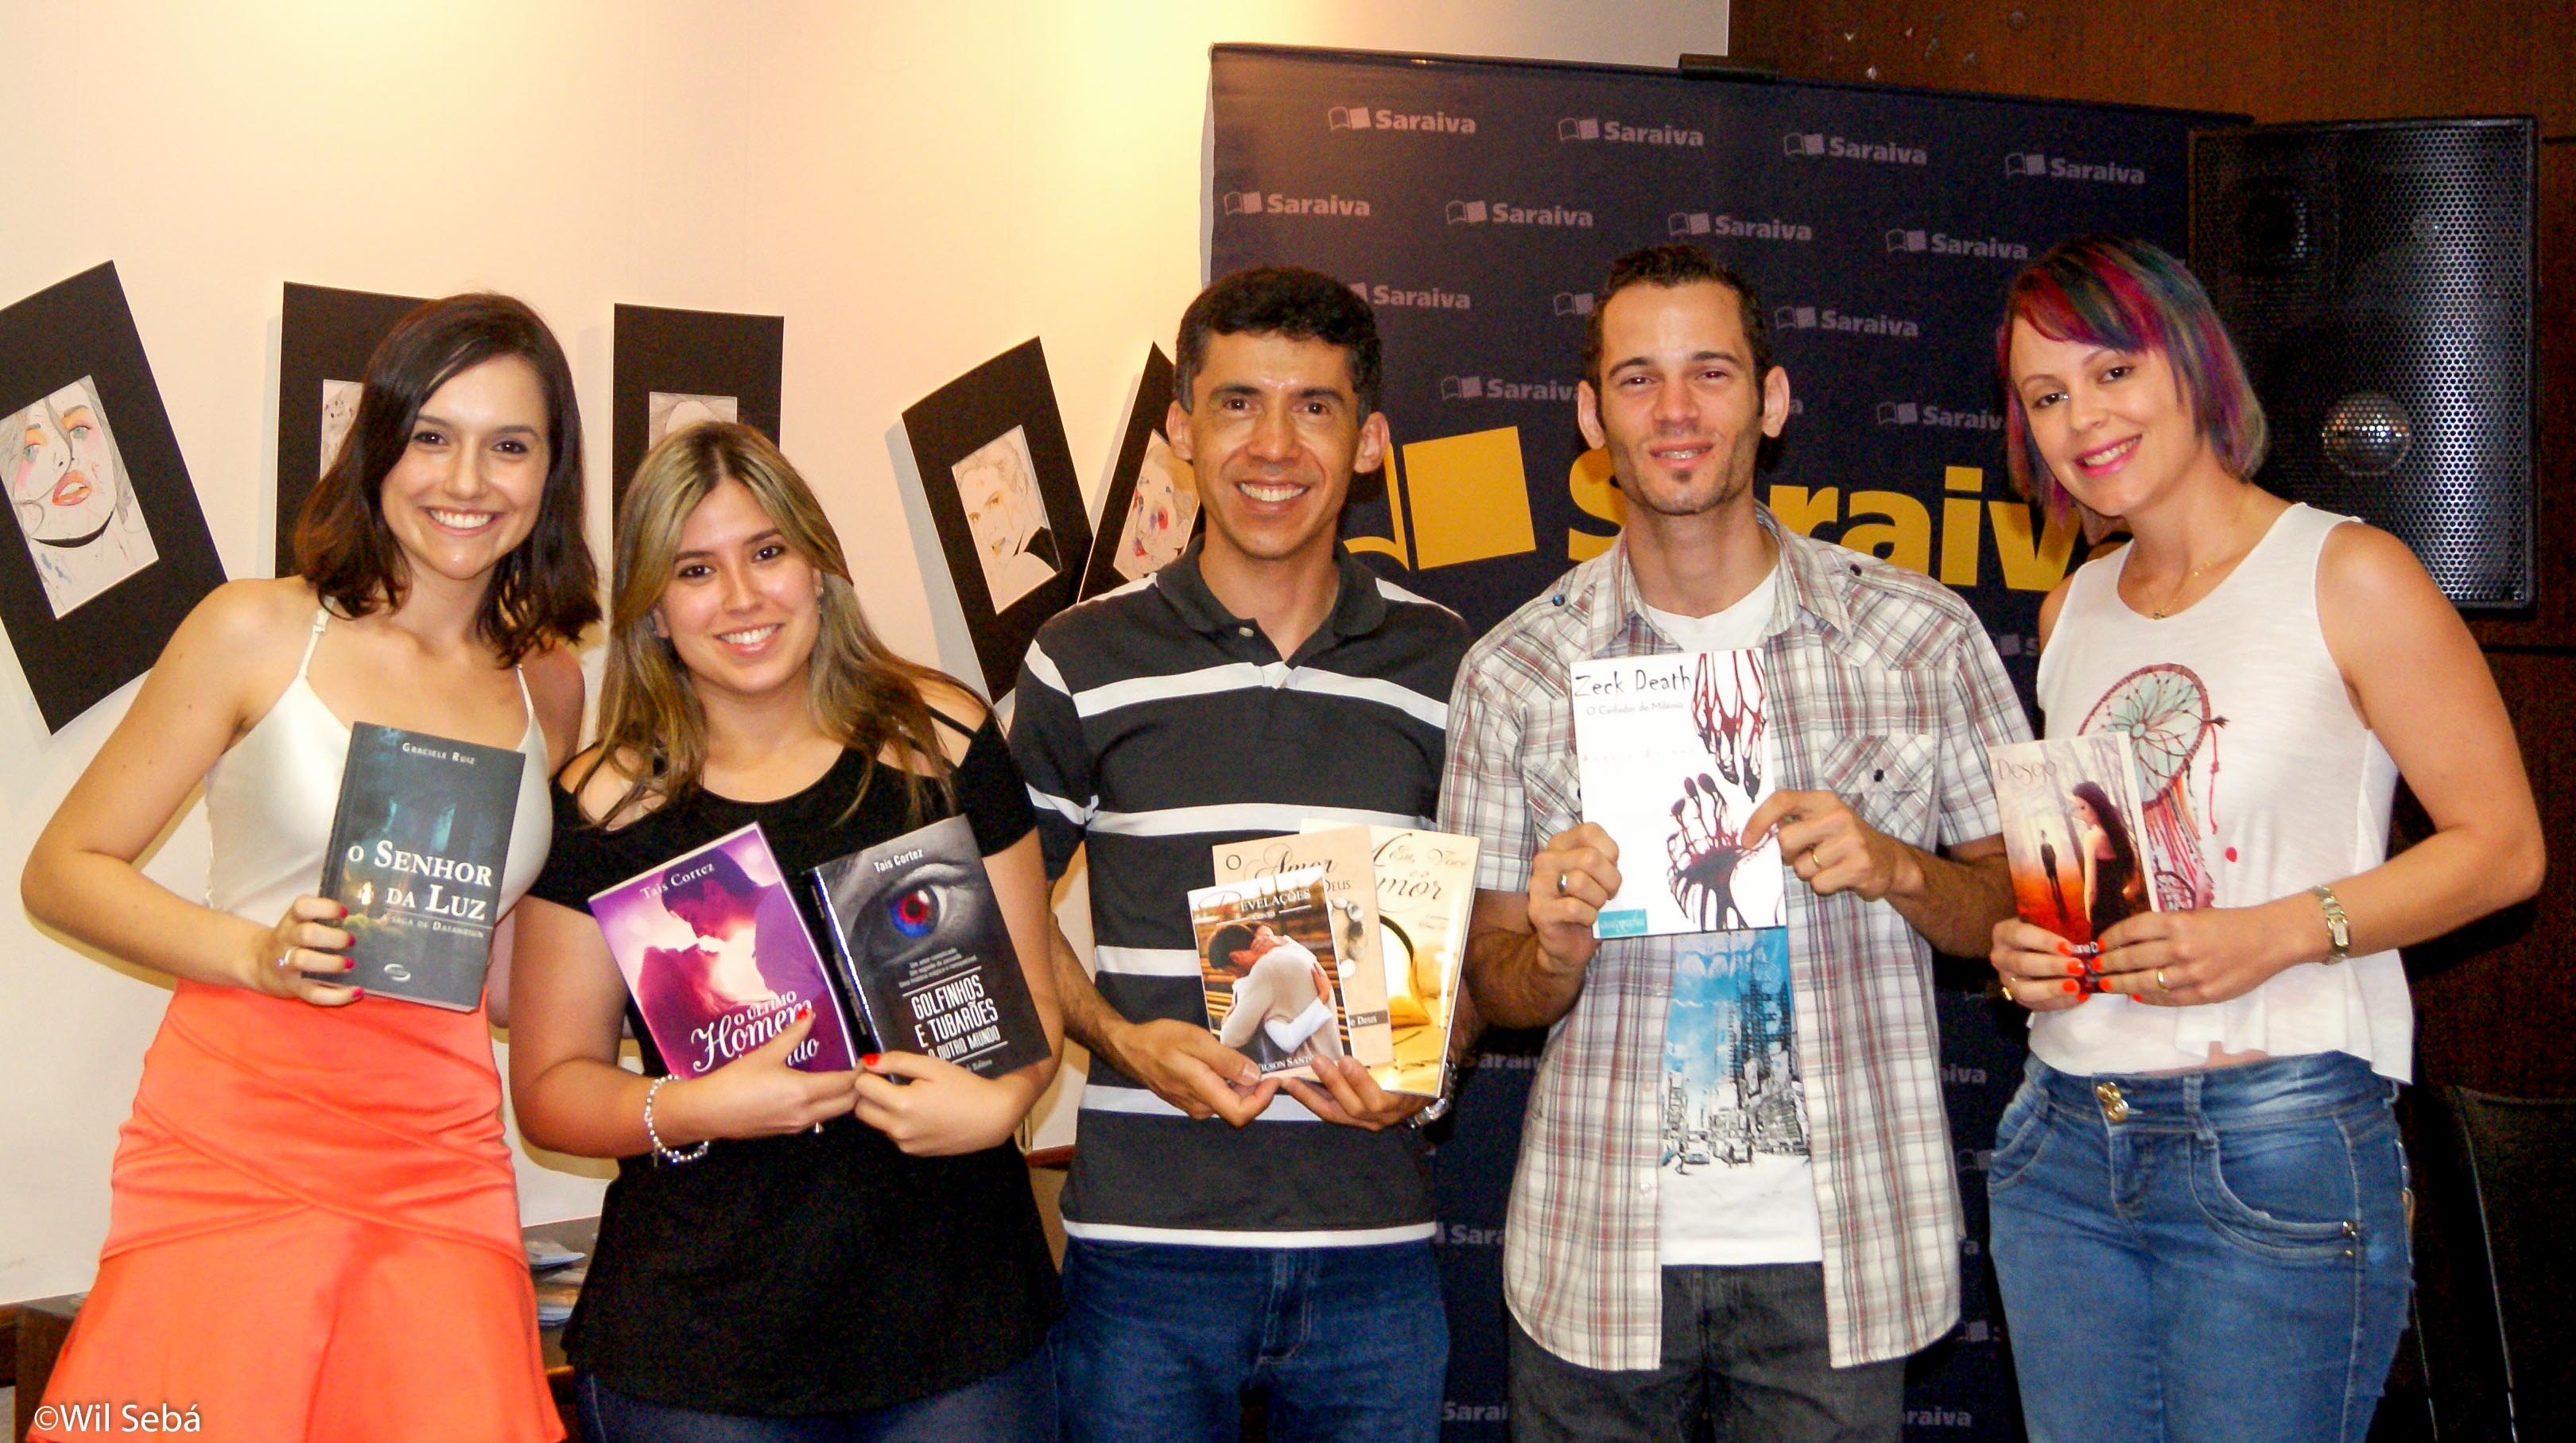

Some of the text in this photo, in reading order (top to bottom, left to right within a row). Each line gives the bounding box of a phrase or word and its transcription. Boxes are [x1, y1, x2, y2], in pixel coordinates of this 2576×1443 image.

[1375, 108, 1476, 134] Saraiva
[1604, 121, 1705, 148] Saraiva
[1829, 135, 1928, 165] Saraiva
[2049, 157, 2145, 184] Saraiva
[1267, 194, 1371, 217] Saraiva
[1492, 202, 1593, 227] Saraiva
[1714, 215, 1813, 241] Saraiva
[1930, 232, 2029, 261] Saraiva
[1373, 284, 1472, 310] Saraiva
[1820, 309, 1919, 338] Saraiva
[1922, 402, 2004, 431] Saraiv
[1574, 665, 1692, 697] Zeck Death
[374, 840, 493, 887] SENHOR
[893, 848, 924, 867] Cortez
[1225, 854, 1242, 871] O
[670, 862, 716, 888] Cortez
[385, 883, 487, 921] DA LUZ
[911, 974, 985, 1021] GOLFINHOS
[733, 1013, 745, 1026] O
[914, 997, 999, 1048] E TUBARÕES
[937, 1037, 968, 1060] OUTRO
[967, 1025, 1001, 1050] MUNDO
[1441, 1399, 1508, 1422] Sarai
